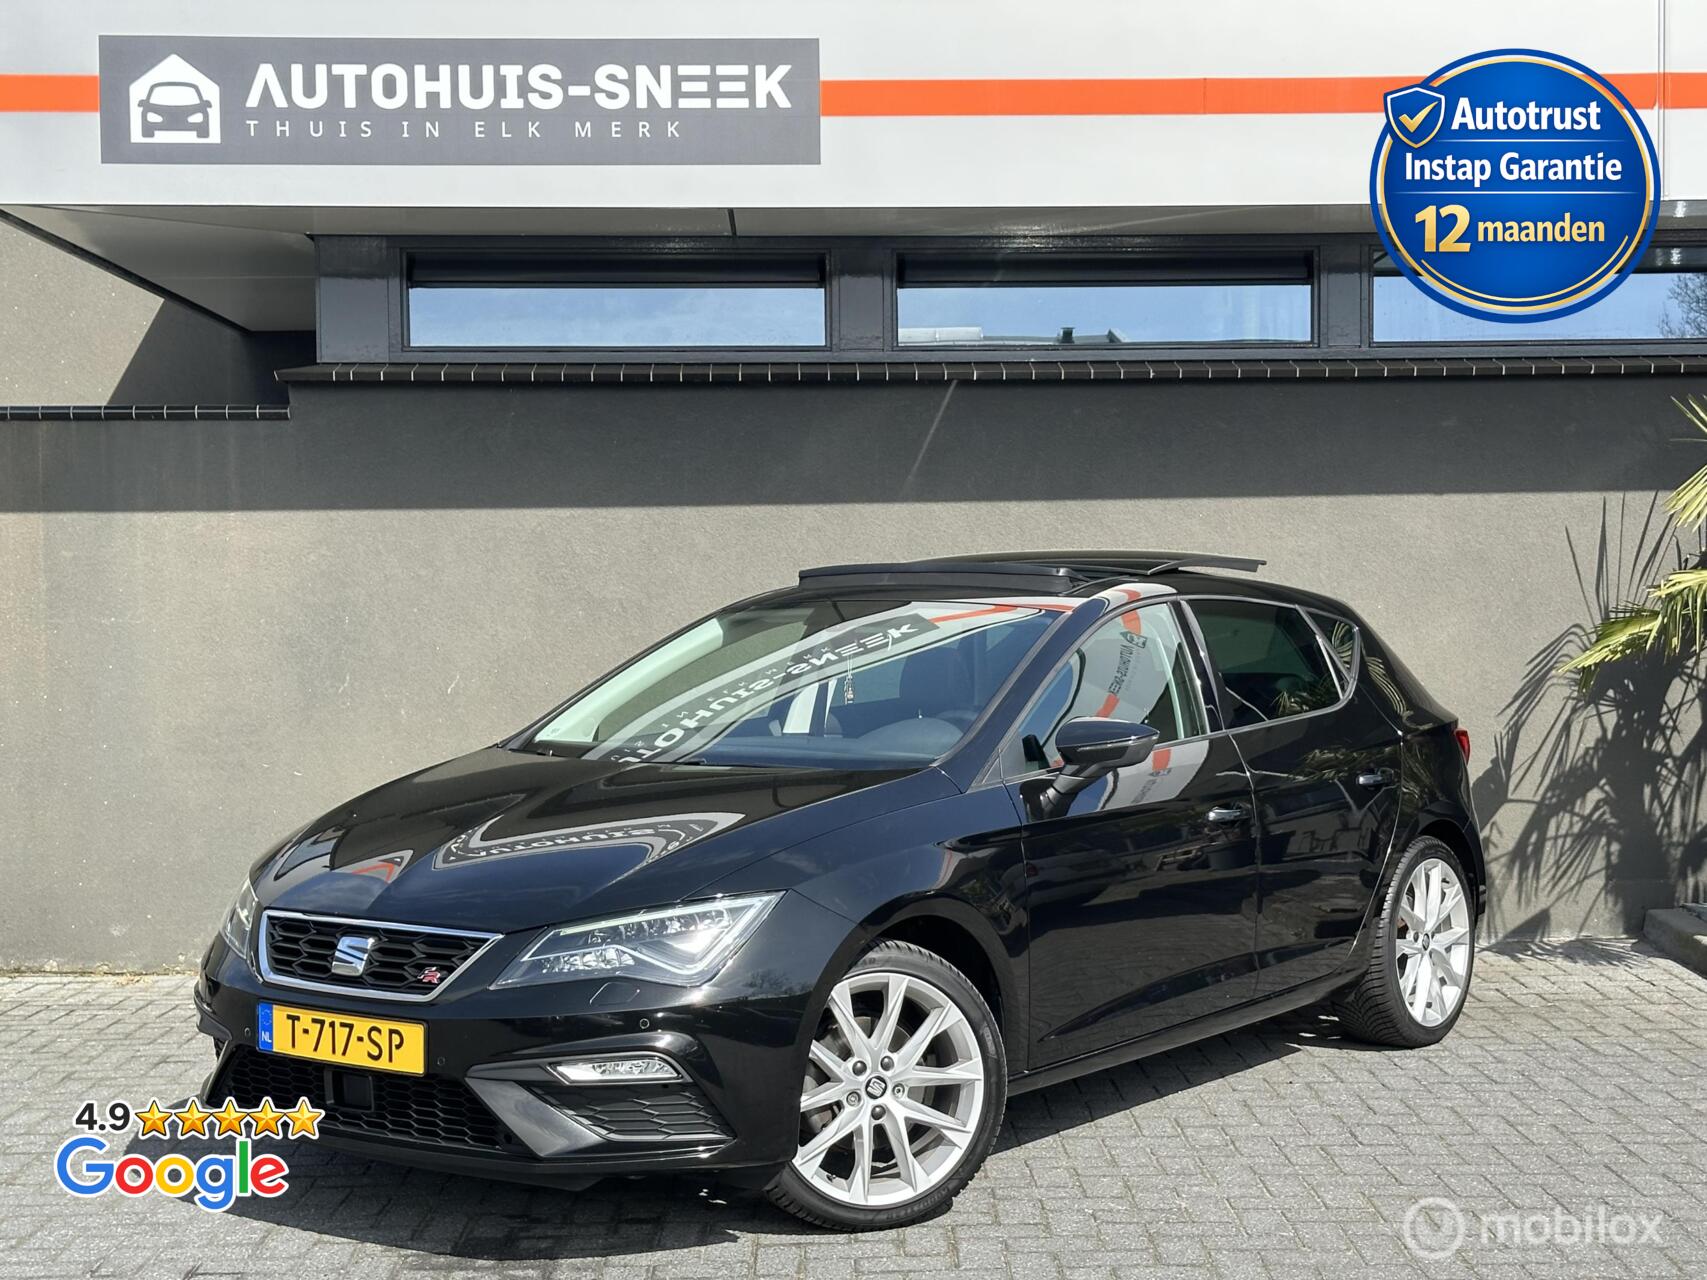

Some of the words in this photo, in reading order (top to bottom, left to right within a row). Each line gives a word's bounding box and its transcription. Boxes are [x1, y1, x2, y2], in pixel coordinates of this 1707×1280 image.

[246, 63, 793, 110] AUTOHUIS-SNEEK
[246, 119, 372, 138] THUIS
[402, 120, 440, 138] IN
[475, 121, 541, 138] ELK
[575, 120, 680, 138] MERK
[261, 1030, 273, 1043] NL
[286, 1013, 405, 1063] T-717-SP
